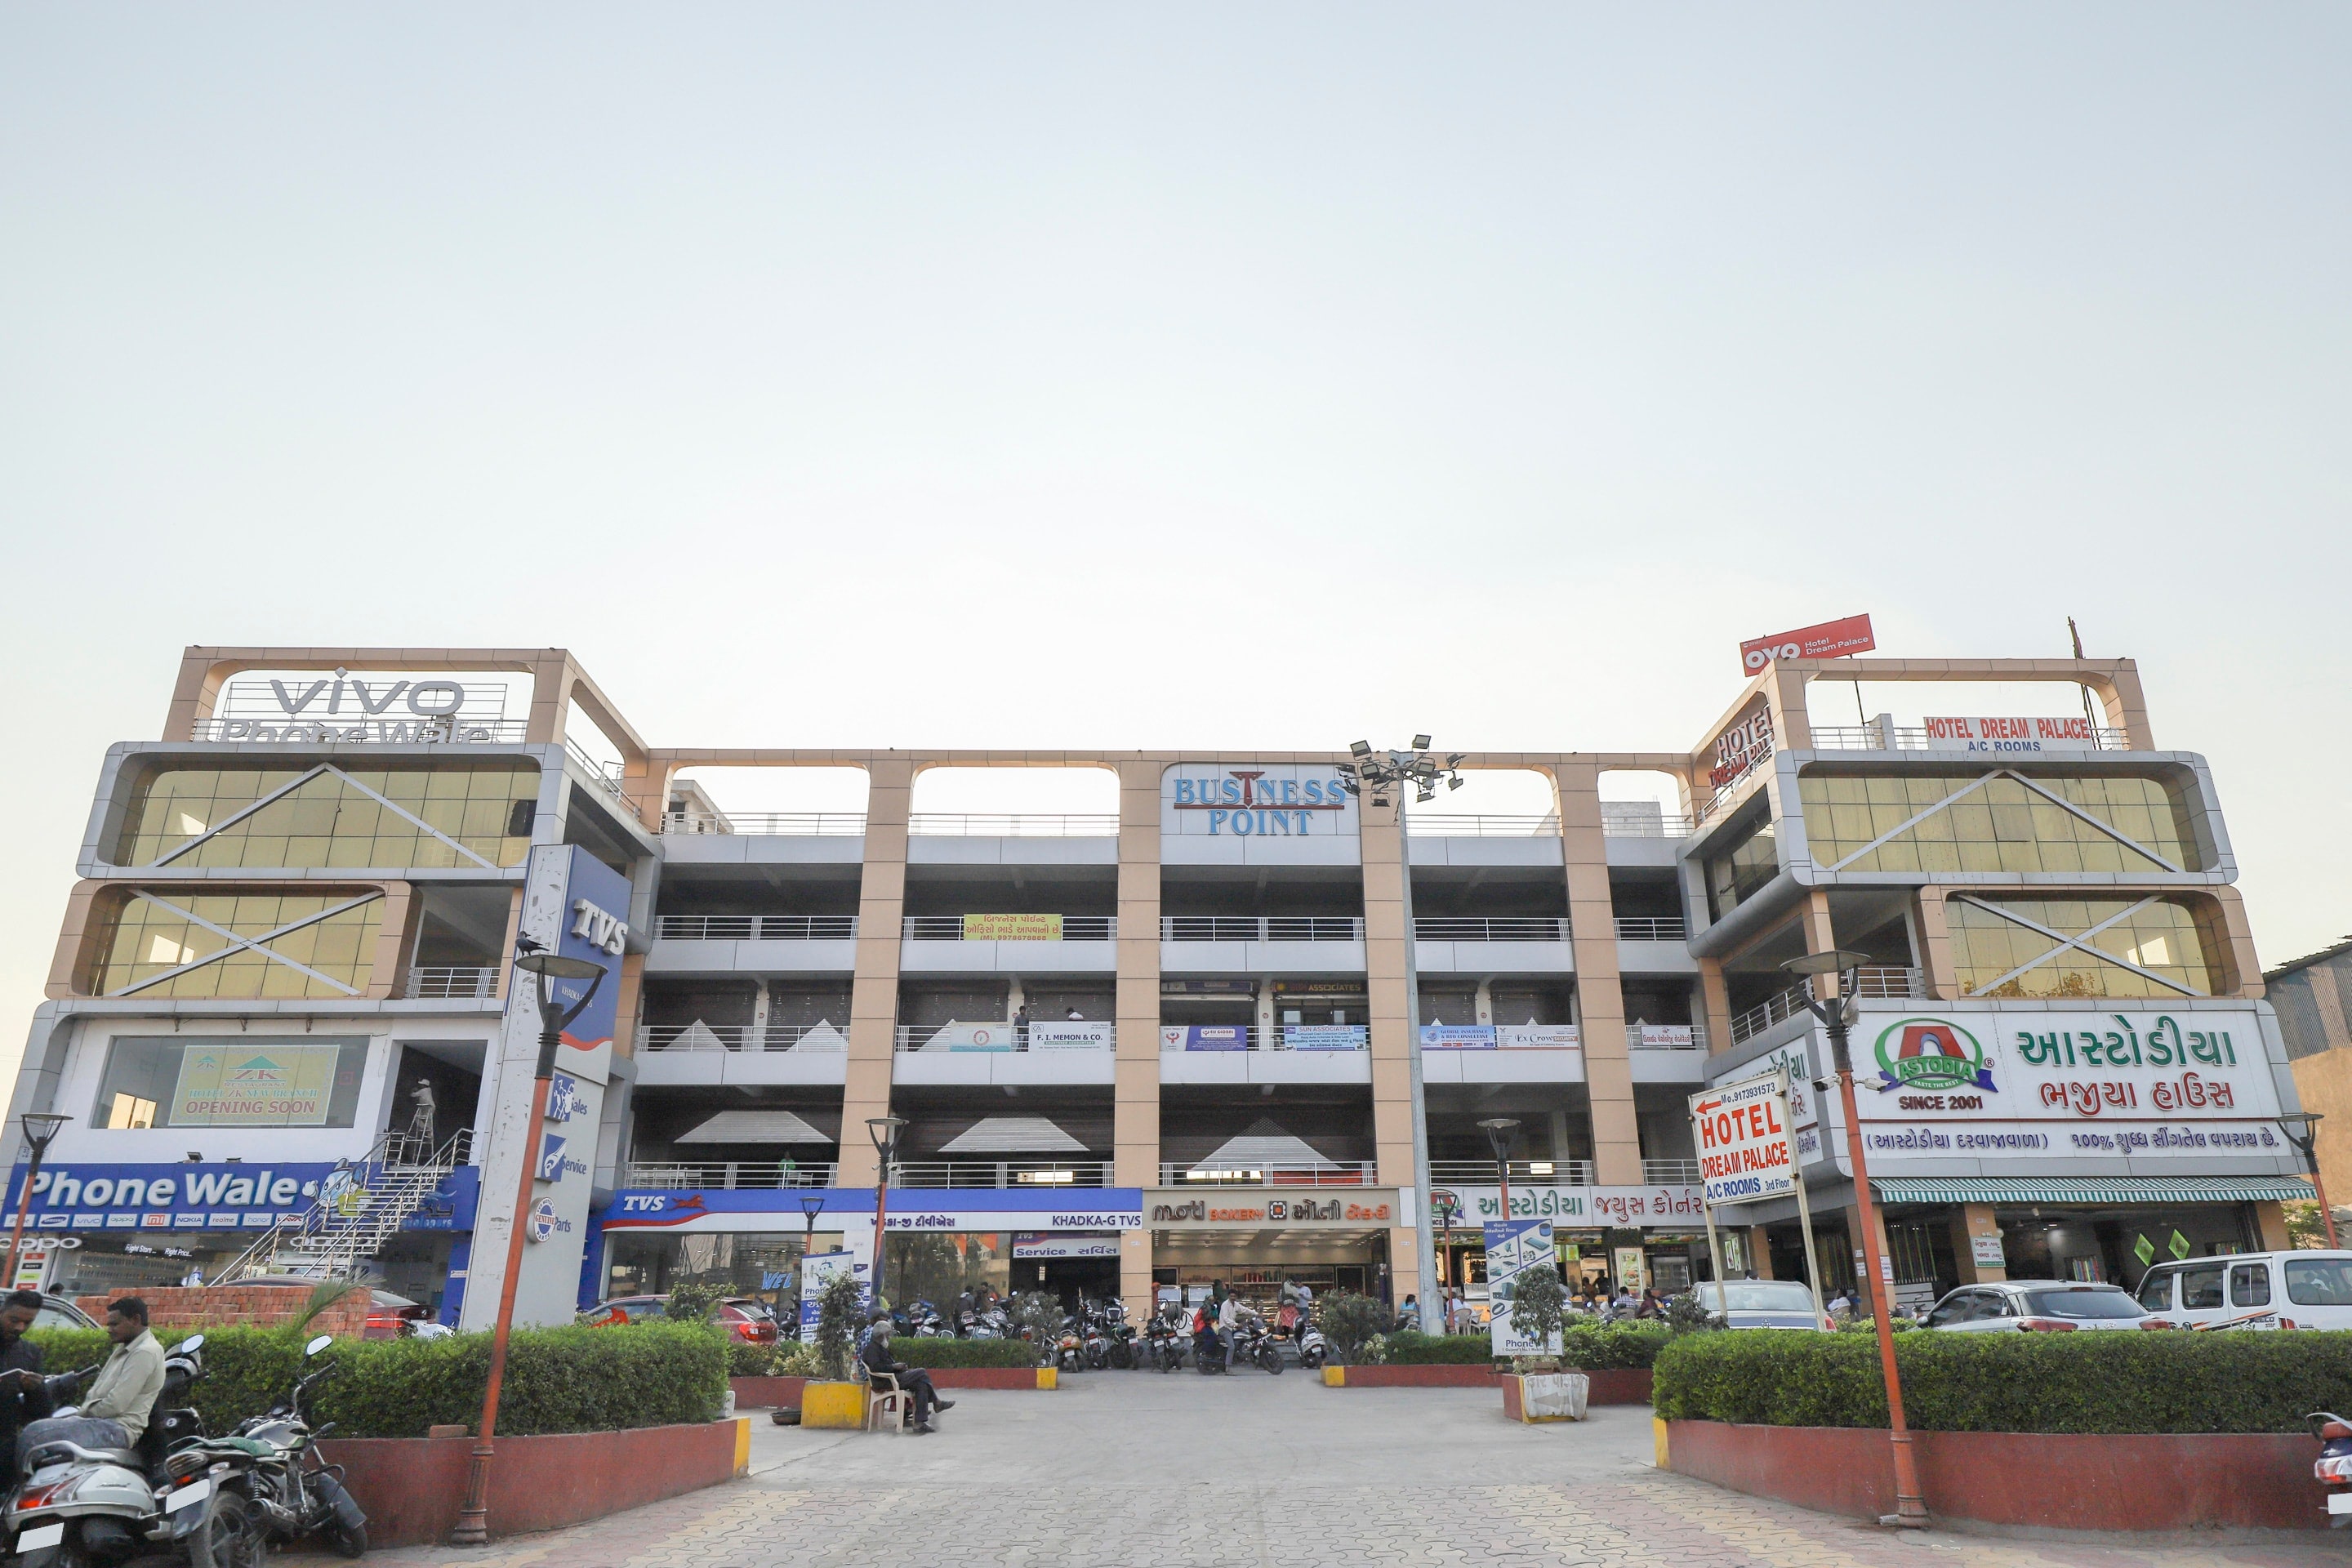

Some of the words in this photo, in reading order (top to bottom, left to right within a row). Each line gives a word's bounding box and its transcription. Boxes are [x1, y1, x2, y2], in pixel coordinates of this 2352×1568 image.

[1804, 637, 1829, 648] Hotel
[1806, 644, 1837, 655] Dream
[1838, 636, 1869, 648] Palace
[1745, 643, 1801, 669] OYO
[270, 666, 465, 715] vivo
[220, 719, 368, 743] Phone
[378, 719, 490, 744] Wale
[1717, 707, 1773, 761] HOTEL
[1926, 718, 1974, 738] HOTEL
[1980, 718, 2031, 738] DREAM
[2037, 718, 2091, 739] PALACE
[1968, 742, 1989, 751] A/C
[1994, 742, 2041, 751] ROOMS
[1708, 751, 1748, 791] DREAM
[1208, 809, 1314, 835] POINT
[571, 898, 629, 956] TVS
[2016, 1013, 2237, 1067] આસ્ટોડીયા
[234, 1069, 278, 1080] ZK
[1897, 1058, 1980, 1084] ASTODIA
[1899, 1096, 1945, 1110] SINCE
[1948, 1096, 1984, 1110] 2001
[2040, 1080, 2138, 1116] ભજીયા
[2152, 1071, 2235, 1111] હાઉસ
[185, 1101, 264, 1114] OPENING
[268, 1101, 316, 1113] SOON
[1700, 1101, 1782, 1149] HOTEL
[2209, 1131, 2258, 1147] વપરાય
[561, 1155, 587, 1175] Service
[1701, 1152, 1742, 1179] DREAM
[1743, 1141, 1789, 1172] PALACE
[16, 1170, 176, 1207] Phone
[185, 1170, 298, 1207] Wale
[1706, 1183, 1722, 1200] A/C
[1723, 1177, 1762, 1198] ROOMS
[1765, 1180, 1775, 1192] 3rd
[1775, 1178, 1790, 1189] Floor
[623, 1195, 666, 1212] TVS
[1152, 1200, 1205, 1221] moti
[1292, 1198, 1341, 1220] મોતી
[1652, 1188, 1704, 1214] કોર્નર
[535, 1214, 555, 1225] GENUINE
[915, 1214, 956, 1227] ટીવીએસ
[1052, 1215, 1116, 1227] KHADKA-G
[1119, 1215, 1142, 1227] TVS
[0, 1237, 82, 1253] oppo
[125, 1243, 139, 1254] Right
[164, 1247, 177, 1257] Right
[1016, 1247, 1067, 1256] Service
[1077, 1245, 1117, 1255] સર્વિસ
[761, 1271, 792, 1290] WEL
[1505, 1339, 1534, 1348] Phone
